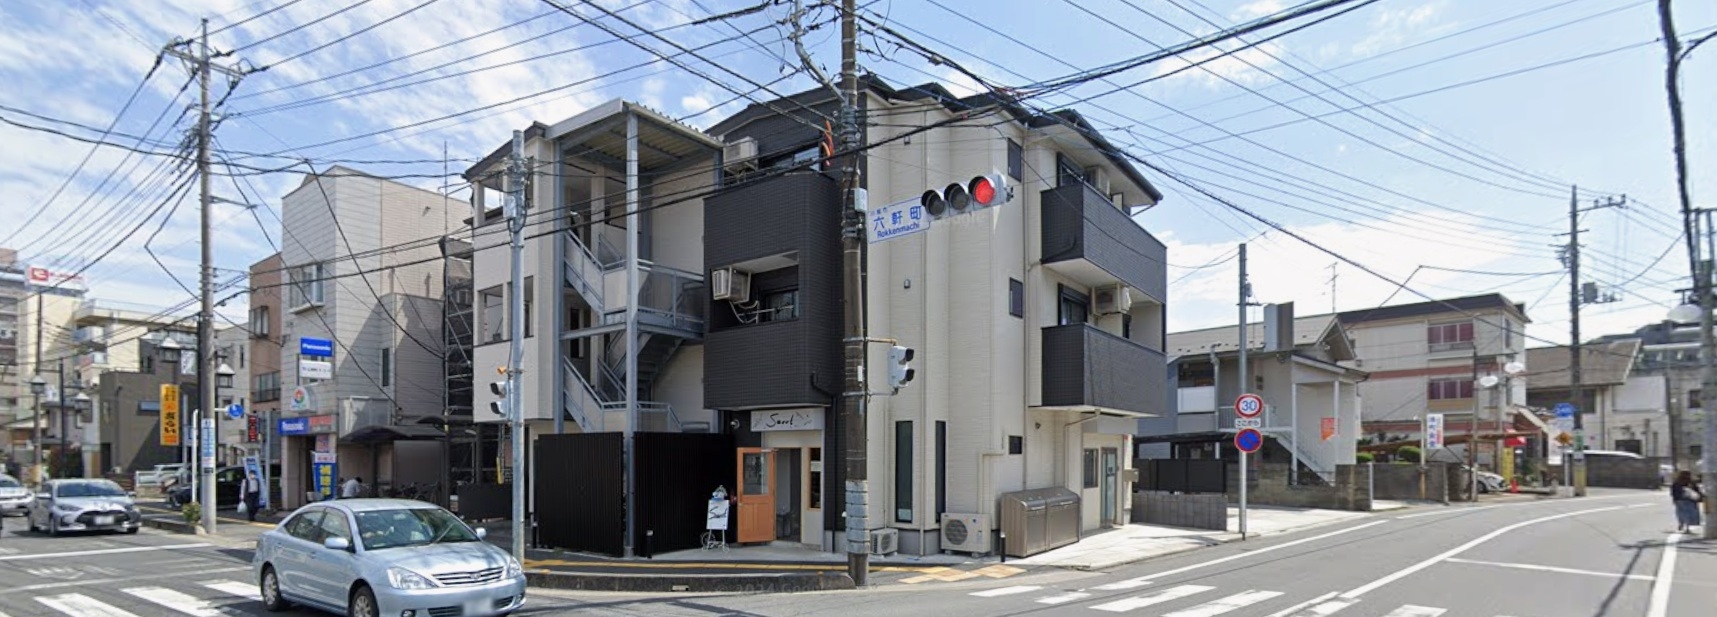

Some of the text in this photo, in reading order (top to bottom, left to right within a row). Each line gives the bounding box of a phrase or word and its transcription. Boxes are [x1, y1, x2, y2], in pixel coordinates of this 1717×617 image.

[873, 206, 922, 231] 六軒町
[876, 221, 921, 239] Rokkenmachi
[302, 342, 331, 352] Panasonic
[1241, 400, 1258, 412] 30
